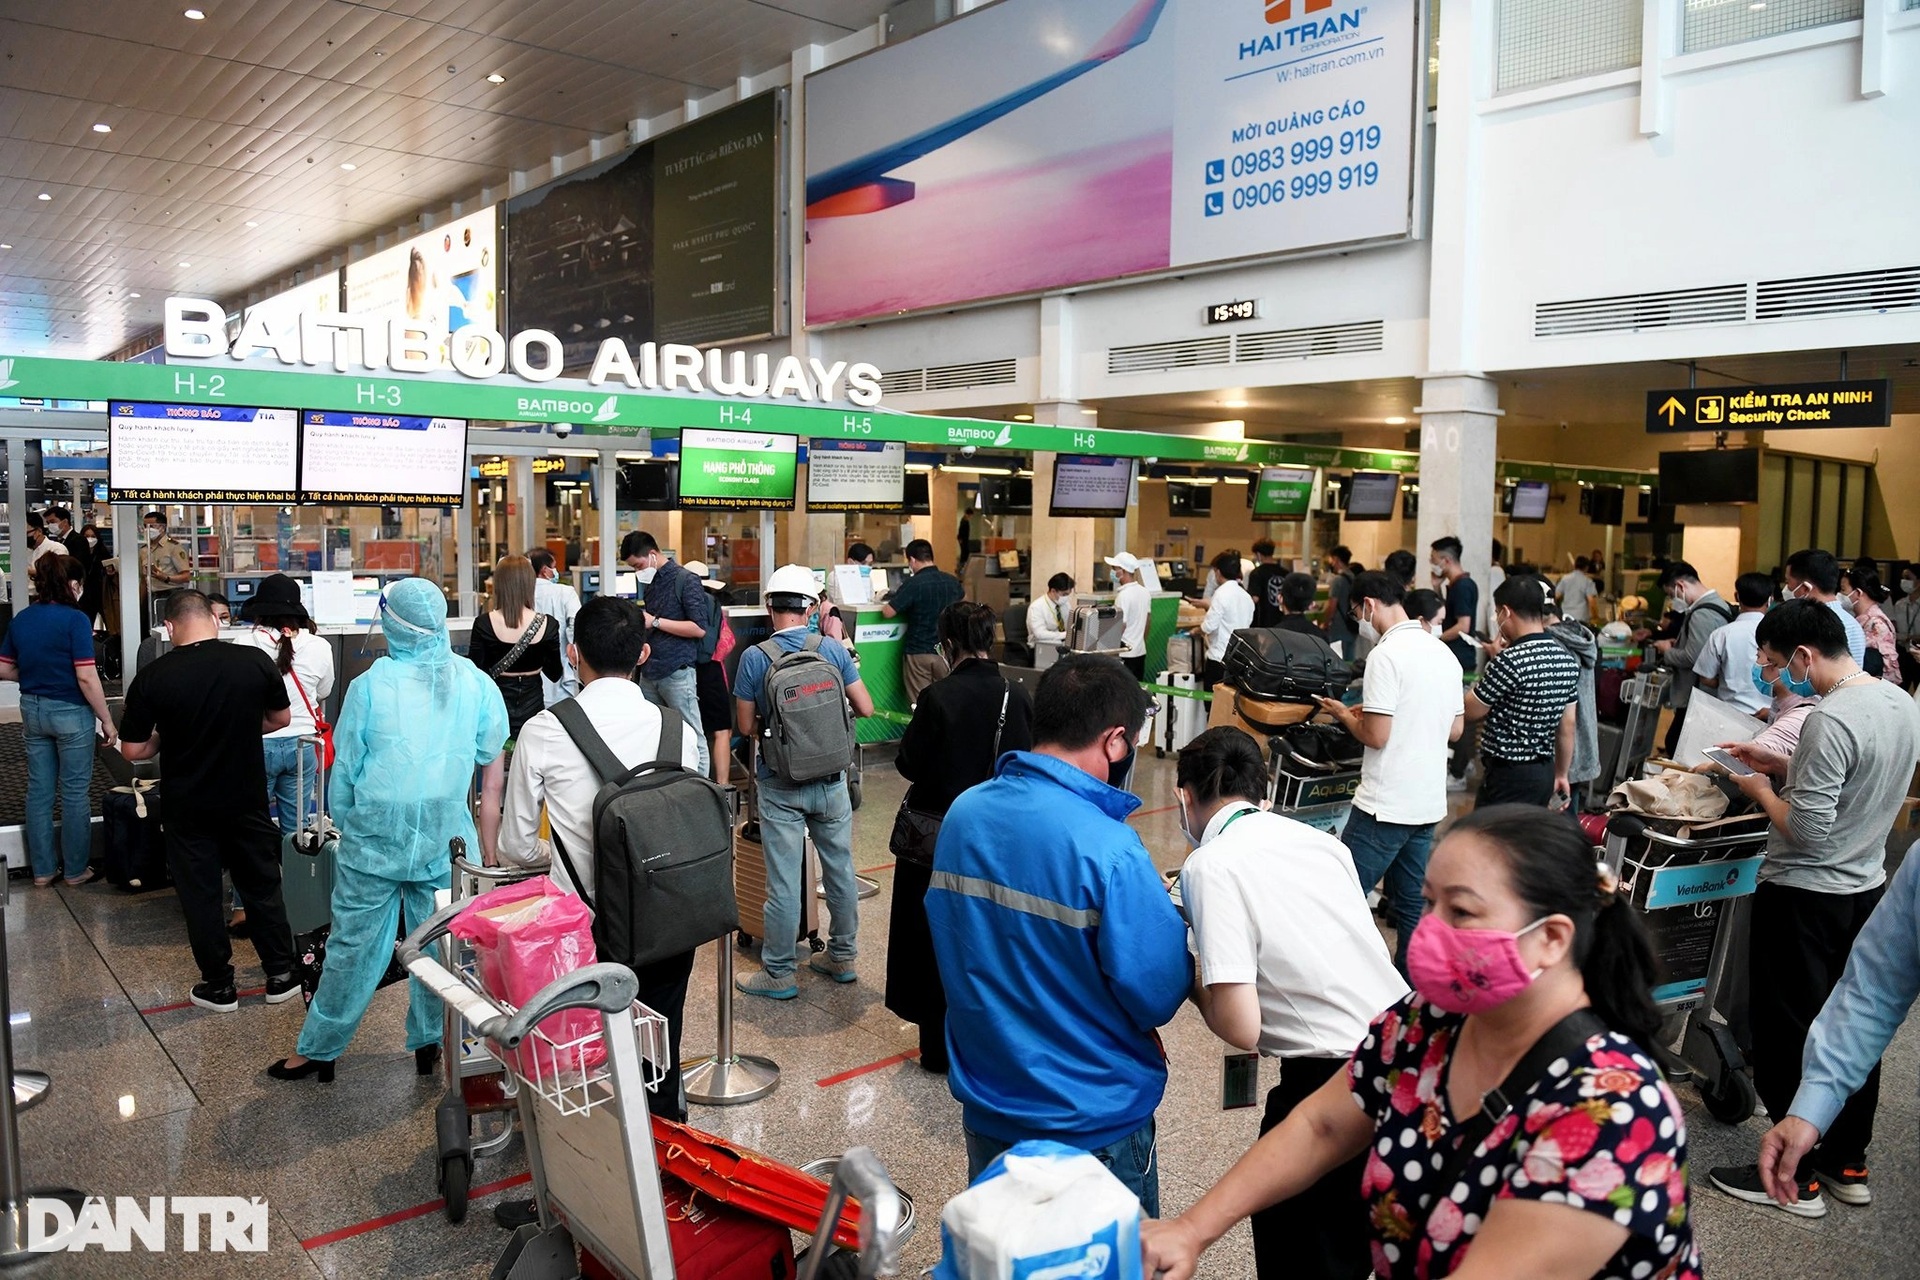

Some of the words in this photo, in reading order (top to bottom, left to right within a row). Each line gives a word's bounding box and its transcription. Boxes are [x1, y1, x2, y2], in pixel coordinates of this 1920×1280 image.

[1277, 69, 1293, 83] W:
[1294, 46, 1385, 79] haitran.com.vn
[1232, 123, 1262, 143] MỜI
[1265, 110, 1324, 136] QUẢNG
[1328, 99, 1366, 121] CÁO
[1231, 146, 1284, 178] 0983
[1291, 135, 1334, 166] 999
[1340, 125, 1382, 155] 919
[1232, 180, 1285, 210] 0906
[1290, 170, 1333, 199] 999
[1338, 161, 1379, 190] 919
[1214, 301, 1253, 321] 15:49
[164, 296, 565, 383] BAMBOO
[588, 336, 884, 407] AIRWAYS
[174, 372, 227, 398] H-2
[356, 383, 402, 407] H-3
[1729, 391, 1767, 409] KIỂM
[1772, 394, 1802, 407] TRA
[1806, 392, 1829, 405] AN
[1833, 391, 1873, 404] NINH
[166, 407, 200, 418] THÔNG
[517, 397, 595, 415] BAMBOO
[518, 411, 549, 419] AIRWAYS
[259, 412, 275, 420] TIA
[719, 405, 753, 426] H-4
[1729, 410, 1782, 424] Security
[1787, 408, 1831, 421] Check
[843, 415, 872, 435] H-5
[947, 427, 996, 440] BAMBOO
[1074, 433, 1095, 448] H-6
[1204, 445, 1238, 457] BAMBOO
[703, 460, 728, 475] HẠNG
[747, 461, 776, 476] THÔNG
[123, 489, 138, 499] Tất
[153, 490, 175, 499] hành
[177, 490, 204, 500] khách
[226, 491, 246, 501] thực
[247, 491, 265, 501] hiện
[266, 492, 284, 500] khai
[308, 492, 321, 500] Tất
[334, 492, 354, 501] hành
[355, 493, 379, 502] khách
[432, 495, 448, 504] khai
[1677, 879, 1726, 896] VietinBank
